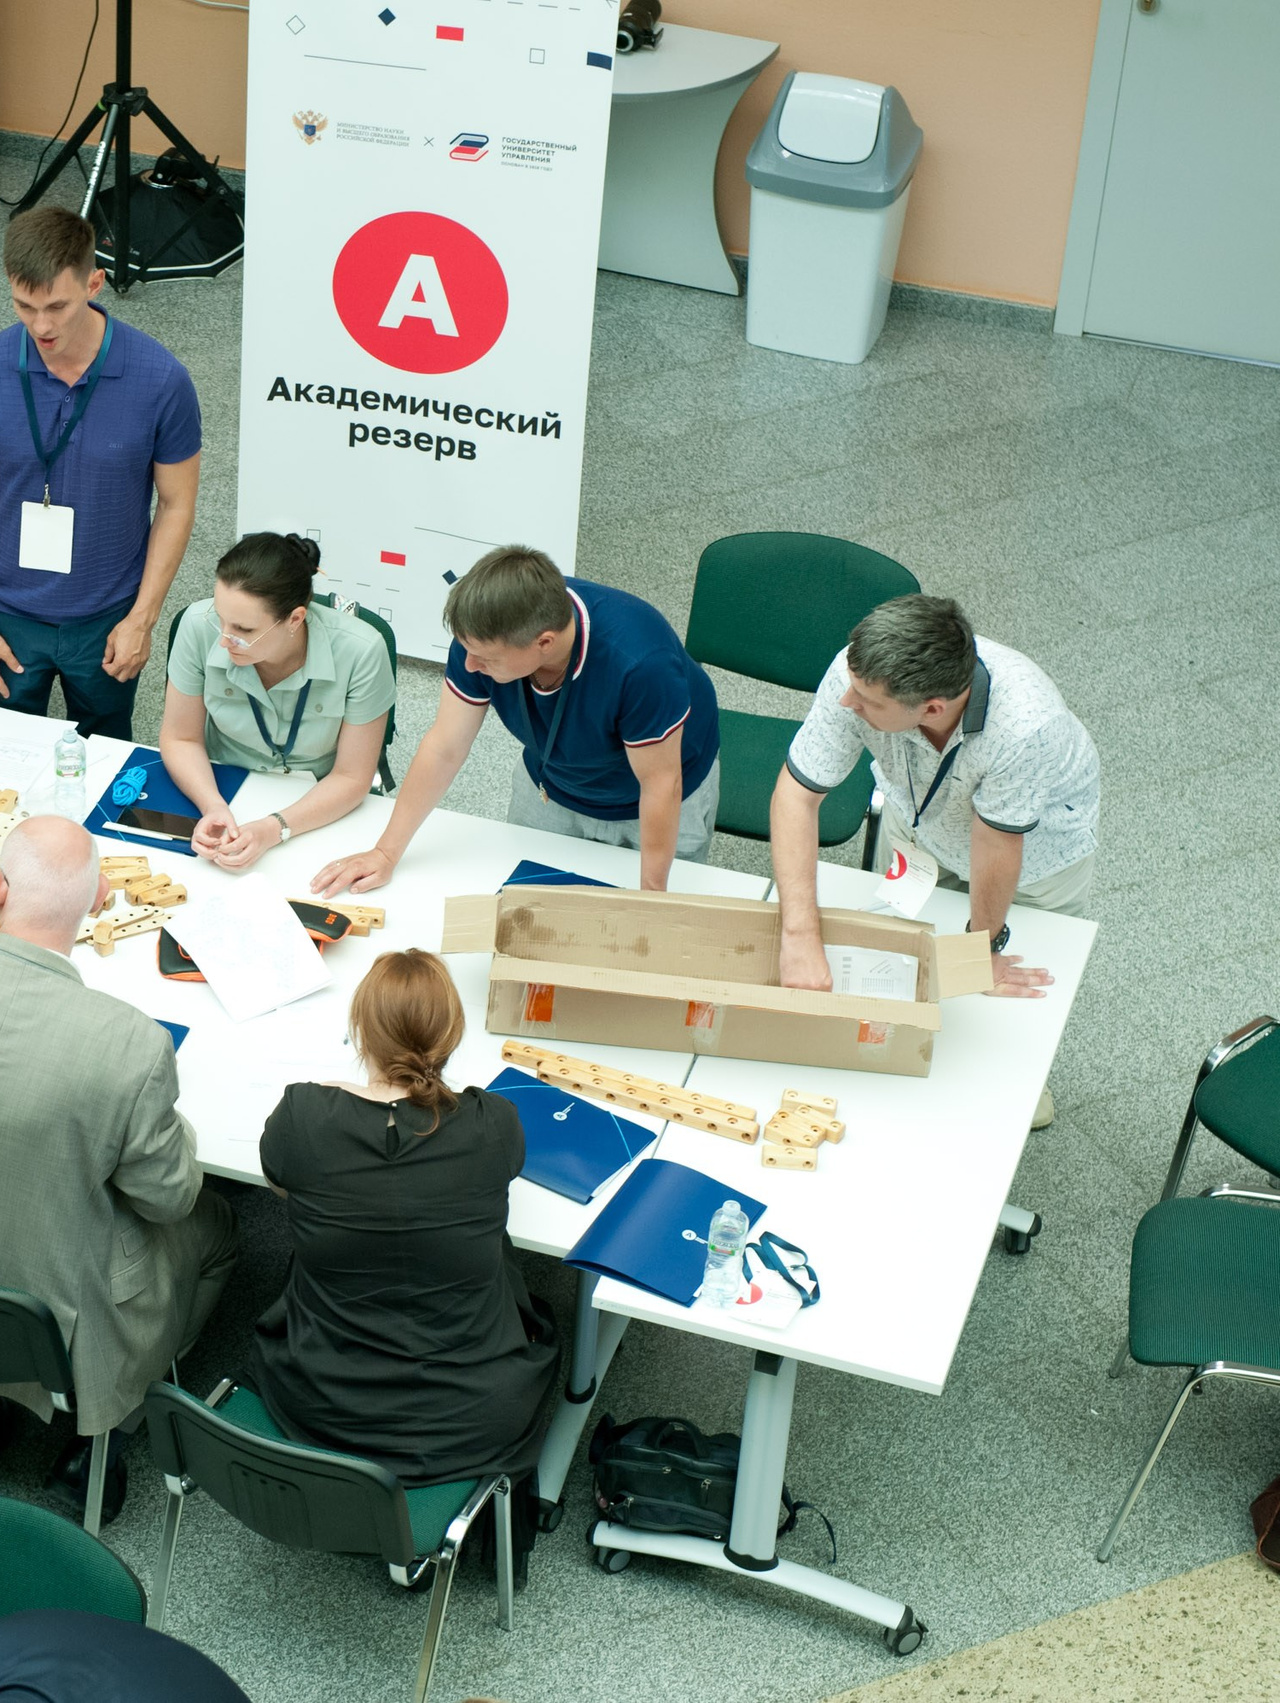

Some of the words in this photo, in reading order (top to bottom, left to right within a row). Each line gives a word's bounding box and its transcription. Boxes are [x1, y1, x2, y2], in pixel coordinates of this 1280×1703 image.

[501, 136, 577, 152] ГОСУДАРСТВЕННЫЙ
[501, 144, 556, 156] УНИВЕРСИТЕТ
[501, 152, 551, 163] УПРАВЛЕНИЯ
[377, 252, 460, 338] А
[266, 376, 563, 440] Академический
[348, 420, 477, 461] резерв
